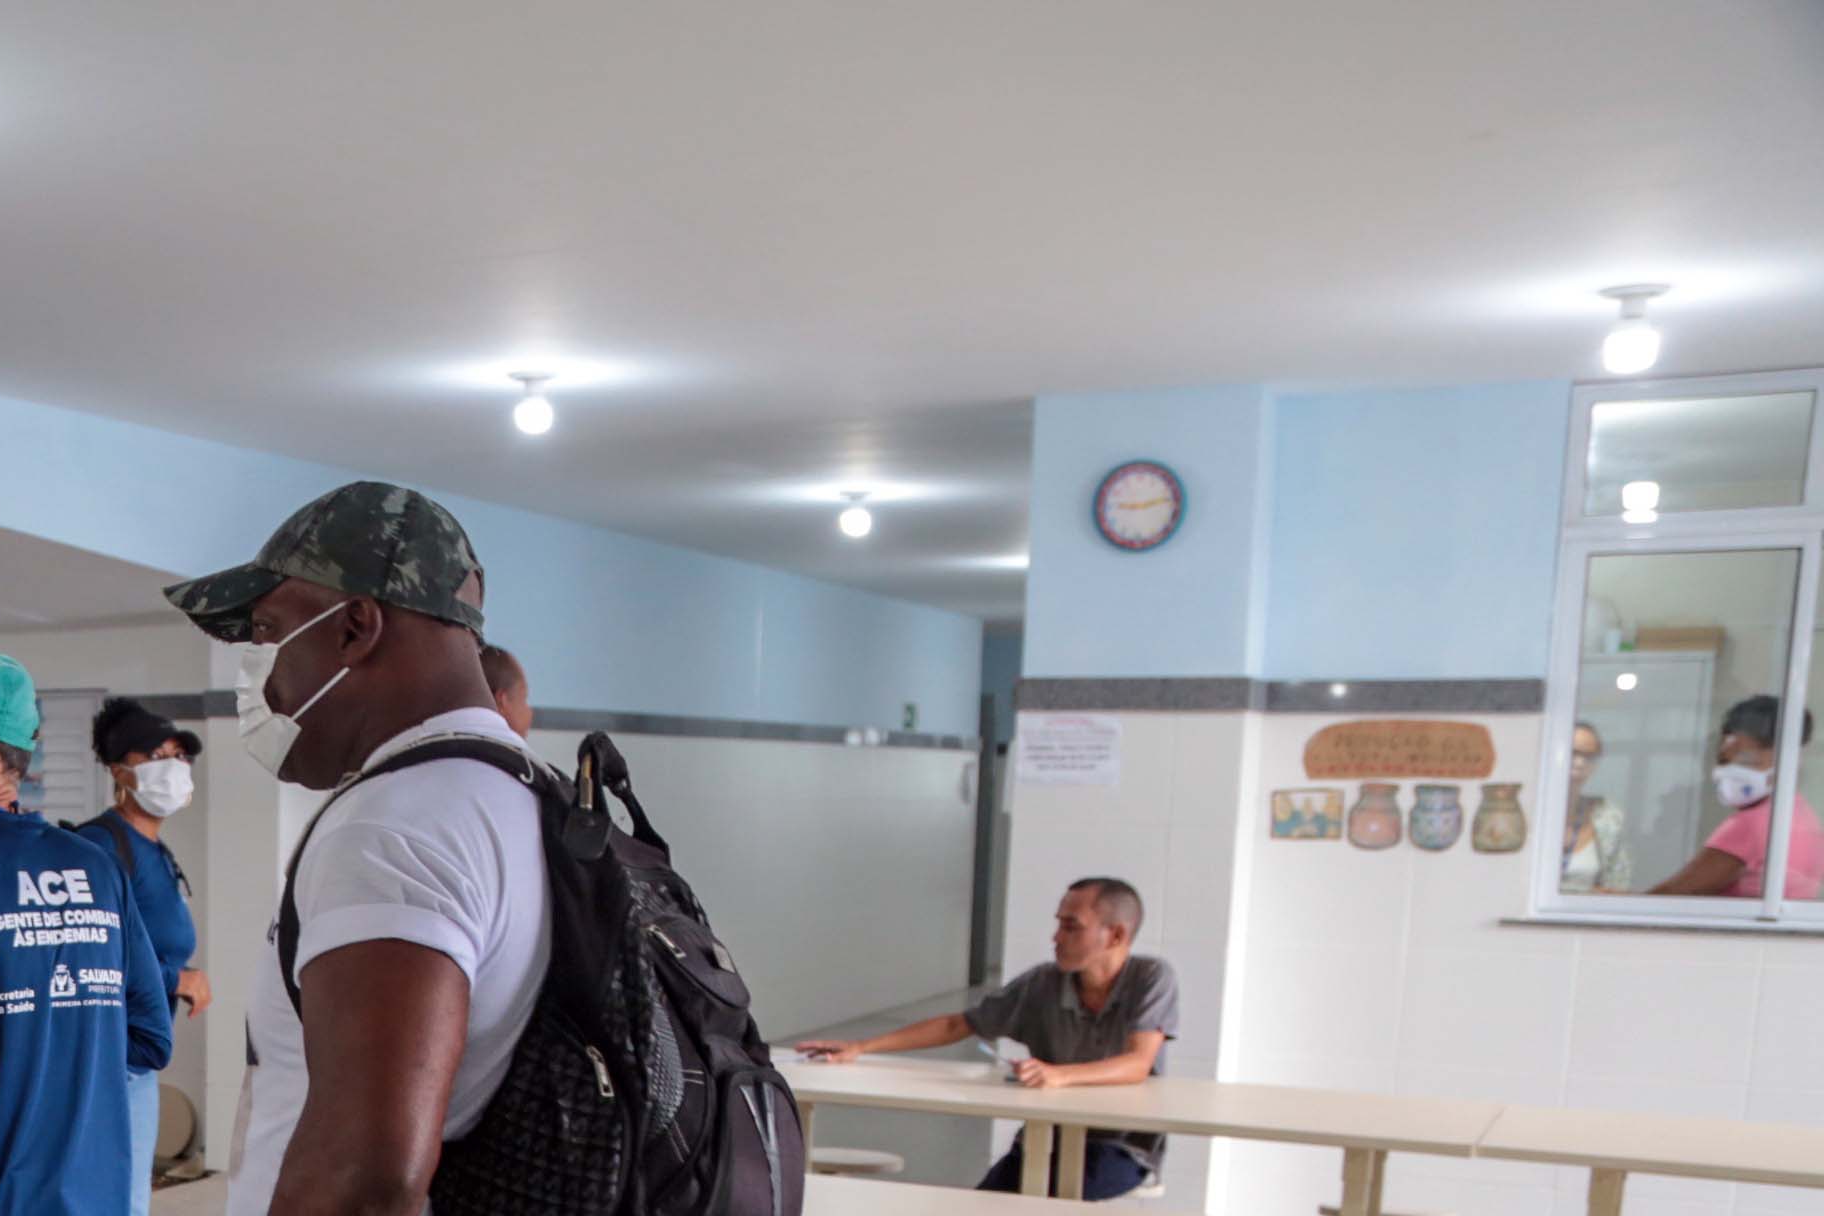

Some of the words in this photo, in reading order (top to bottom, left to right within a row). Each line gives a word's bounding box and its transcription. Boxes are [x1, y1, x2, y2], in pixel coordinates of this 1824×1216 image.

[17, 869, 93, 906] ACE
[42, 911, 63, 927] DE
[36, 927, 108, 946] ENDEMIAS
[6, 1001, 35, 1014] Saúde
